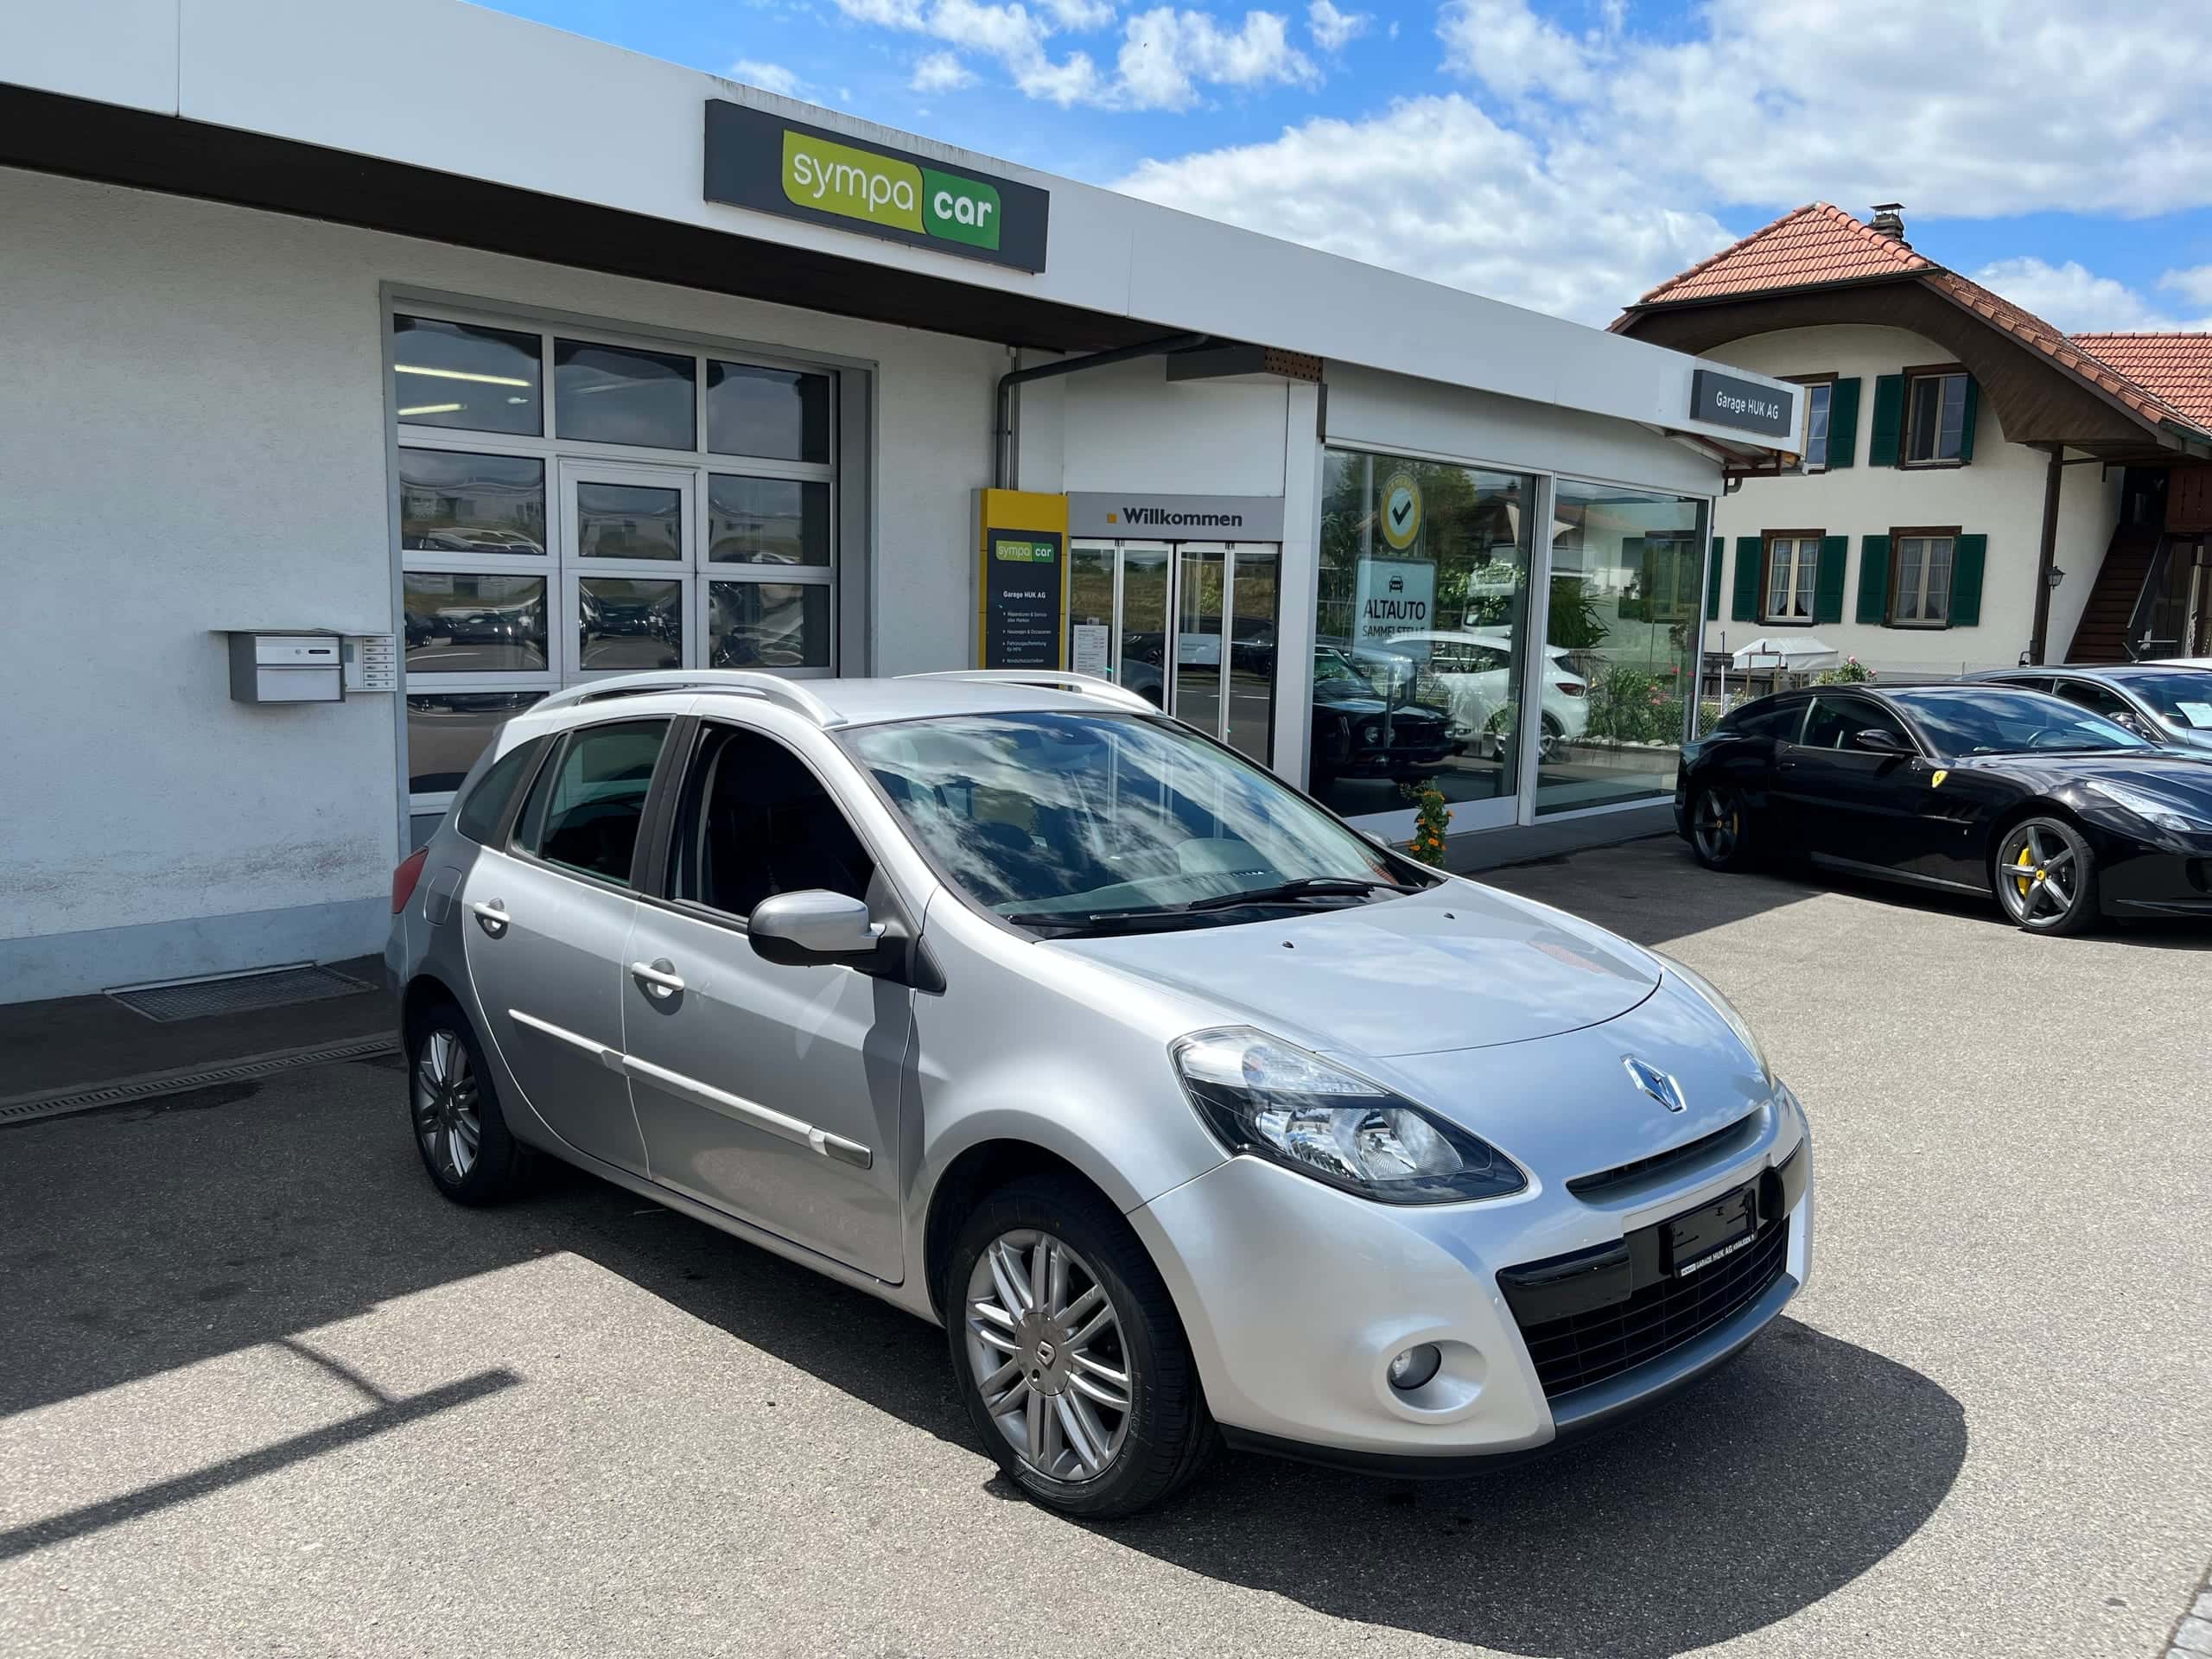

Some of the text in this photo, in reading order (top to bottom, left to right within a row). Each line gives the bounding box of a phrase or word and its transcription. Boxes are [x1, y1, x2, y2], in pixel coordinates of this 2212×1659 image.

[792, 152, 993, 227] sympa car
[1716, 391, 1778, 420] Garage HUK AG
[1122, 507, 1243, 527] Willkommen
[998, 545, 1052, 558] sympa car
[1003, 590, 1023, 599] Garage
[1363, 599, 1426, 620] ALTAUTO
[1713, 1249, 1725, 1261] HUK
[1725, 1245, 1732, 1255] AG
